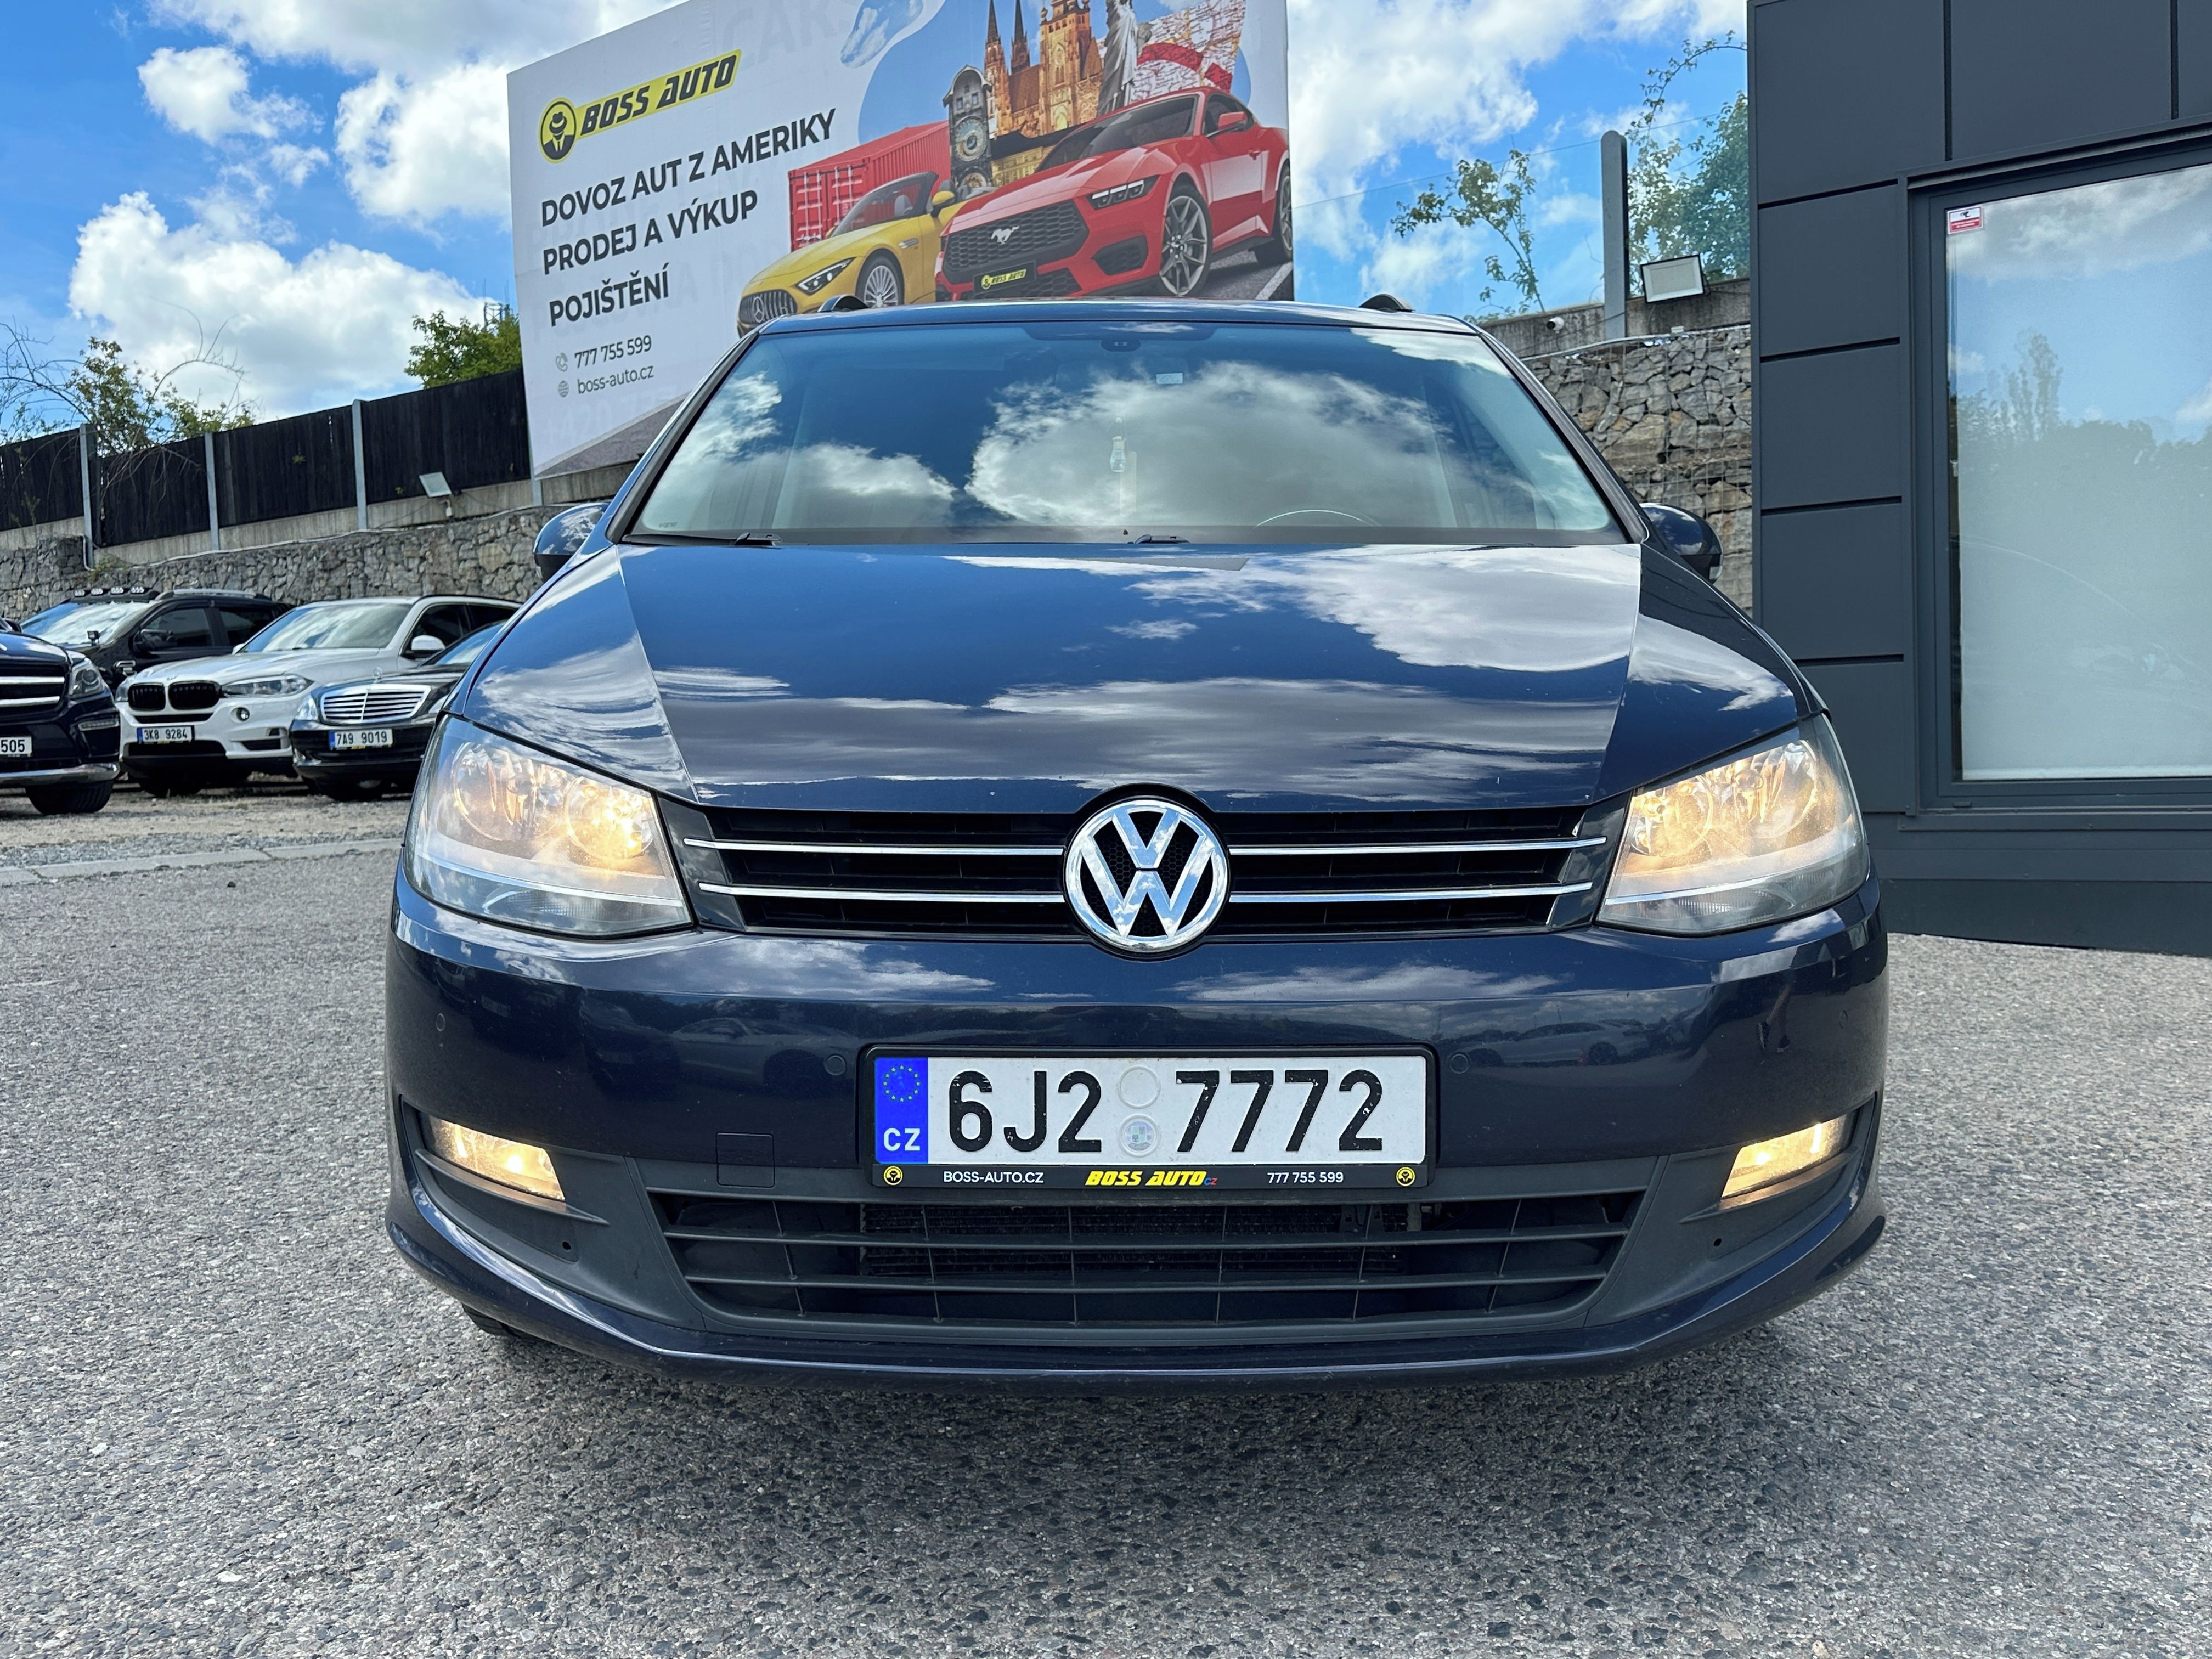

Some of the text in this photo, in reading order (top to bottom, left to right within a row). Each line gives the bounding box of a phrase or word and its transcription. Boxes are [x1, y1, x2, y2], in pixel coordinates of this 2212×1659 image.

[580, 55, 737, 136] BOSS AUTO
[541, 108, 836, 227] DOVOZ AUT Z AMERIKY
[543, 190, 758, 275] PRODEJ A VÝKUP
[549, 262, 670, 327] POJIŠTĚNÍ
[574, 335, 652, 369] 777 755 599
[577, 365, 654, 394] boss-auto.cz
[1, 739, 25, 753] 505
[165, 728, 187, 740] 9284
[337, 731, 387, 746] 7A9 9019
[1074, 803, 1220, 946] VW
[883, 1069, 1383, 1153] CZ 6J2 7772
[943, 1171, 1044, 1184] BOSS-AUTO.CZ
[1084, 1170, 1143, 1186] BOSS
[1144, 1170, 1207, 1186] AUTO
[1267, 1172, 1289, 1183] 777
[1292, 1171, 1316, 1183] 755
[1319, 1171, 1344, 1183] 599
